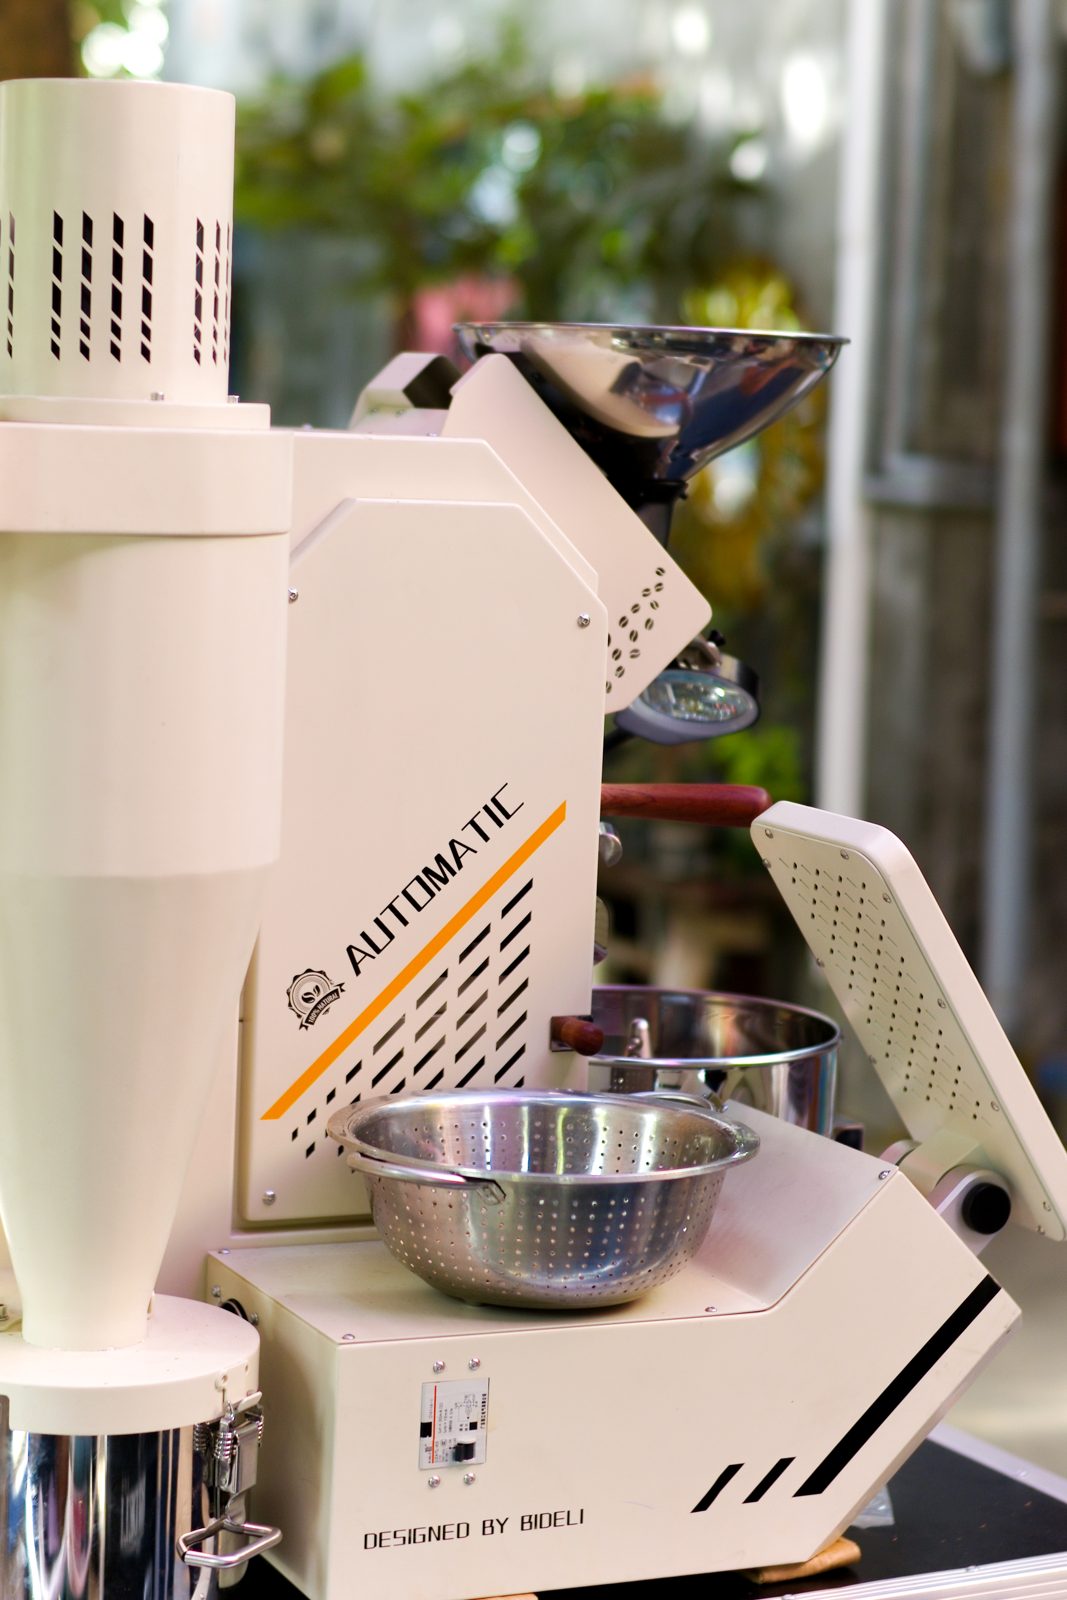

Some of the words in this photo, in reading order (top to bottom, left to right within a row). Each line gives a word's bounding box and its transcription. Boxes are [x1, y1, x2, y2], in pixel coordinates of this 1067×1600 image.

[346, 782, 524, 977] AUTOMATIC
[308, 1008, 321, 1023] 100%
[317, 992, 339, 1010] NATURAL
[363, 1522, 470, 1550] DESIGNED
[482, 1517, 509, 1536] BY
[520, 1508, 584, 1532] BIDELI
